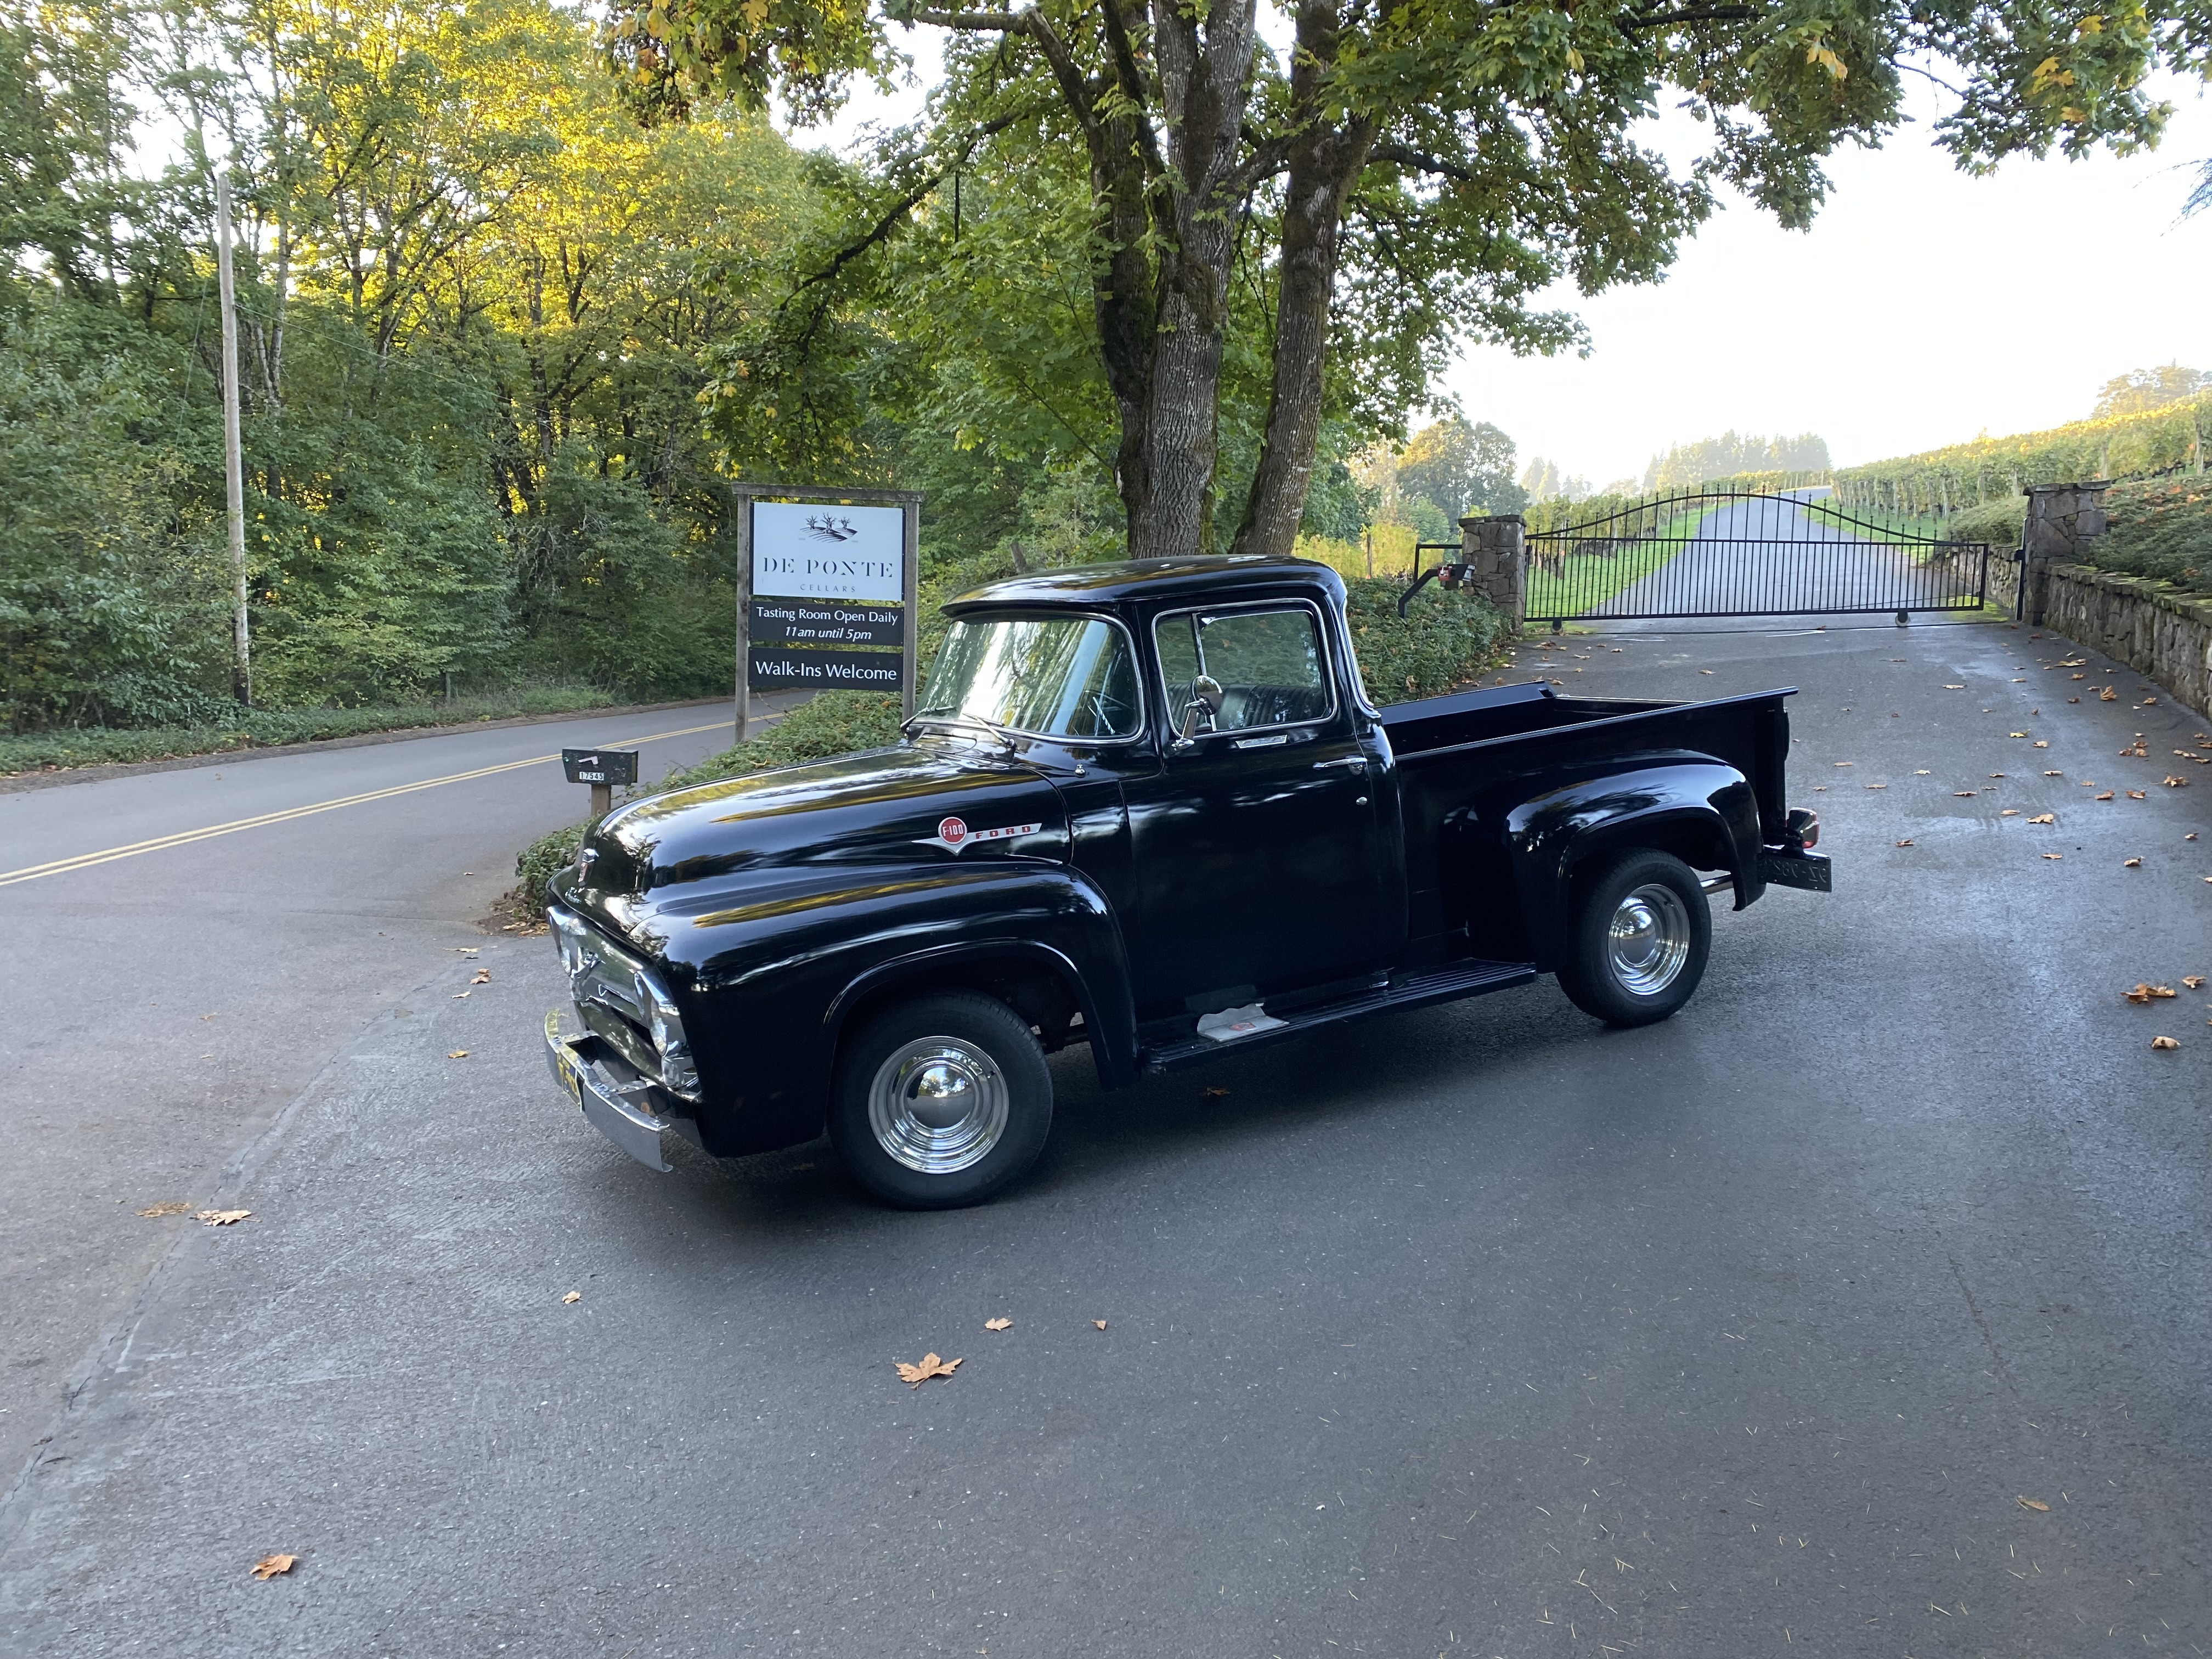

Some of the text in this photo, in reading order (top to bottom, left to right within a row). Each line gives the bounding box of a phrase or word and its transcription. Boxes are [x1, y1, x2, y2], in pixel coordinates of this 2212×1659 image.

[764, 557, 893, 578] DE PONTE
[800, 584, 856, 593] CELLARS
[756, 606, 898, 626] Tasting Room Open Daily
[785, 626, 872, 642] 11am until 5pm
[755, 661, 897, 680] Walk-Ins Welcome
[942, 824, 964, 837] F-100
[975, 825, 1031, 839] FORD
